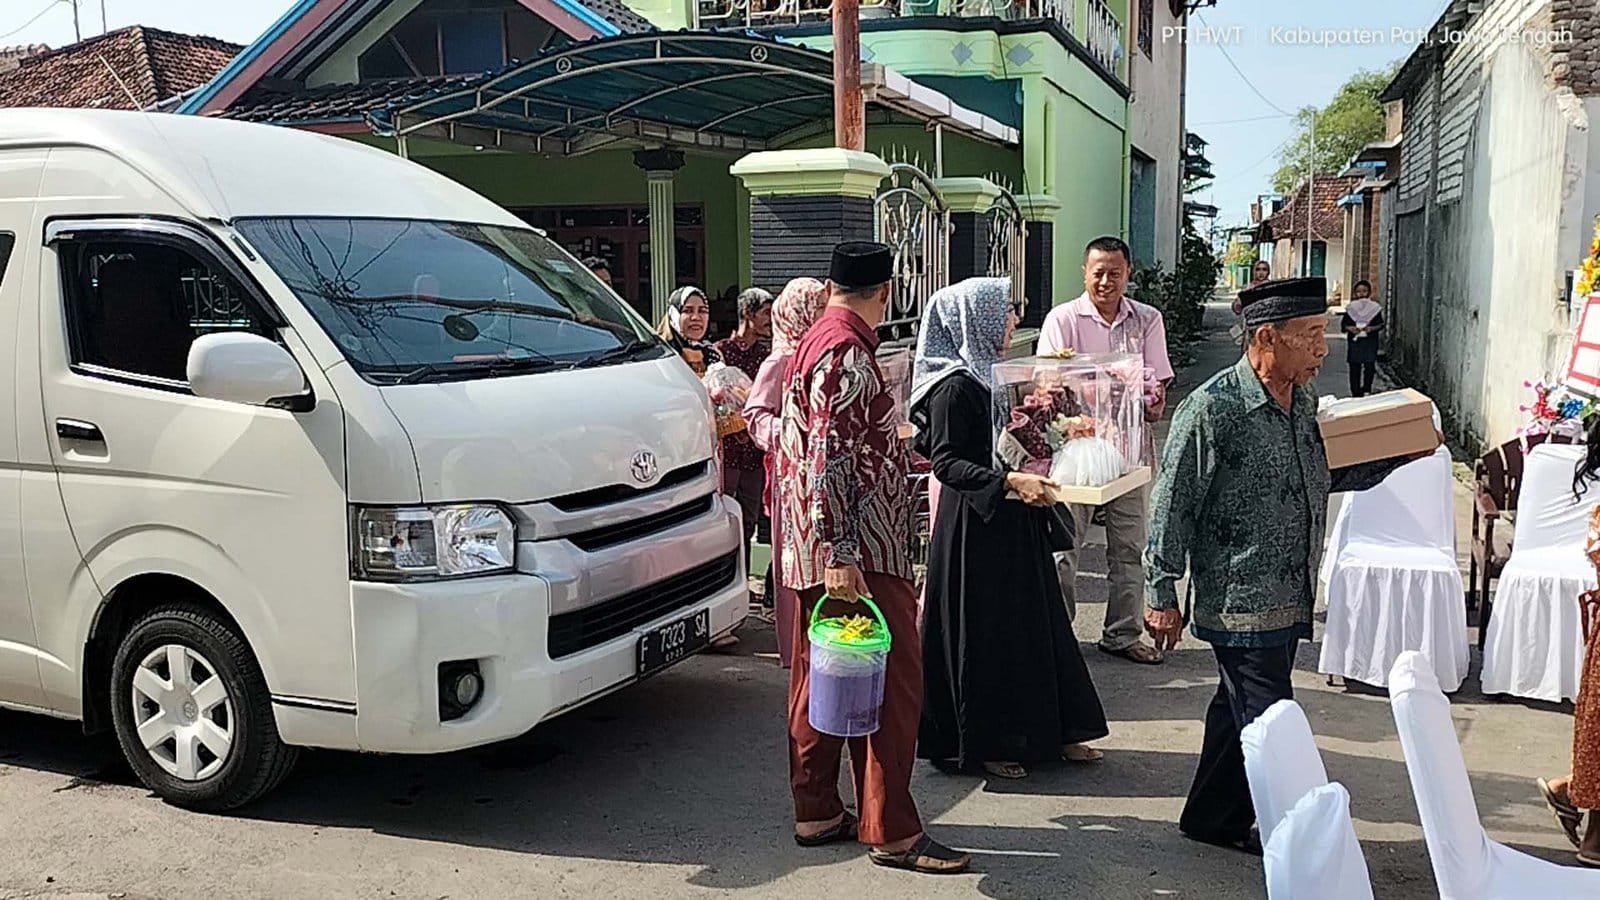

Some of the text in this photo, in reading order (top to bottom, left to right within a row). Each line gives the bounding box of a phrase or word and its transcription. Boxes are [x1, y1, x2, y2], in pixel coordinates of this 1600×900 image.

[641, 636, 648, 661] F
[659, 621, 686, 653] 7323
[695, 612, 707, 638] SA
